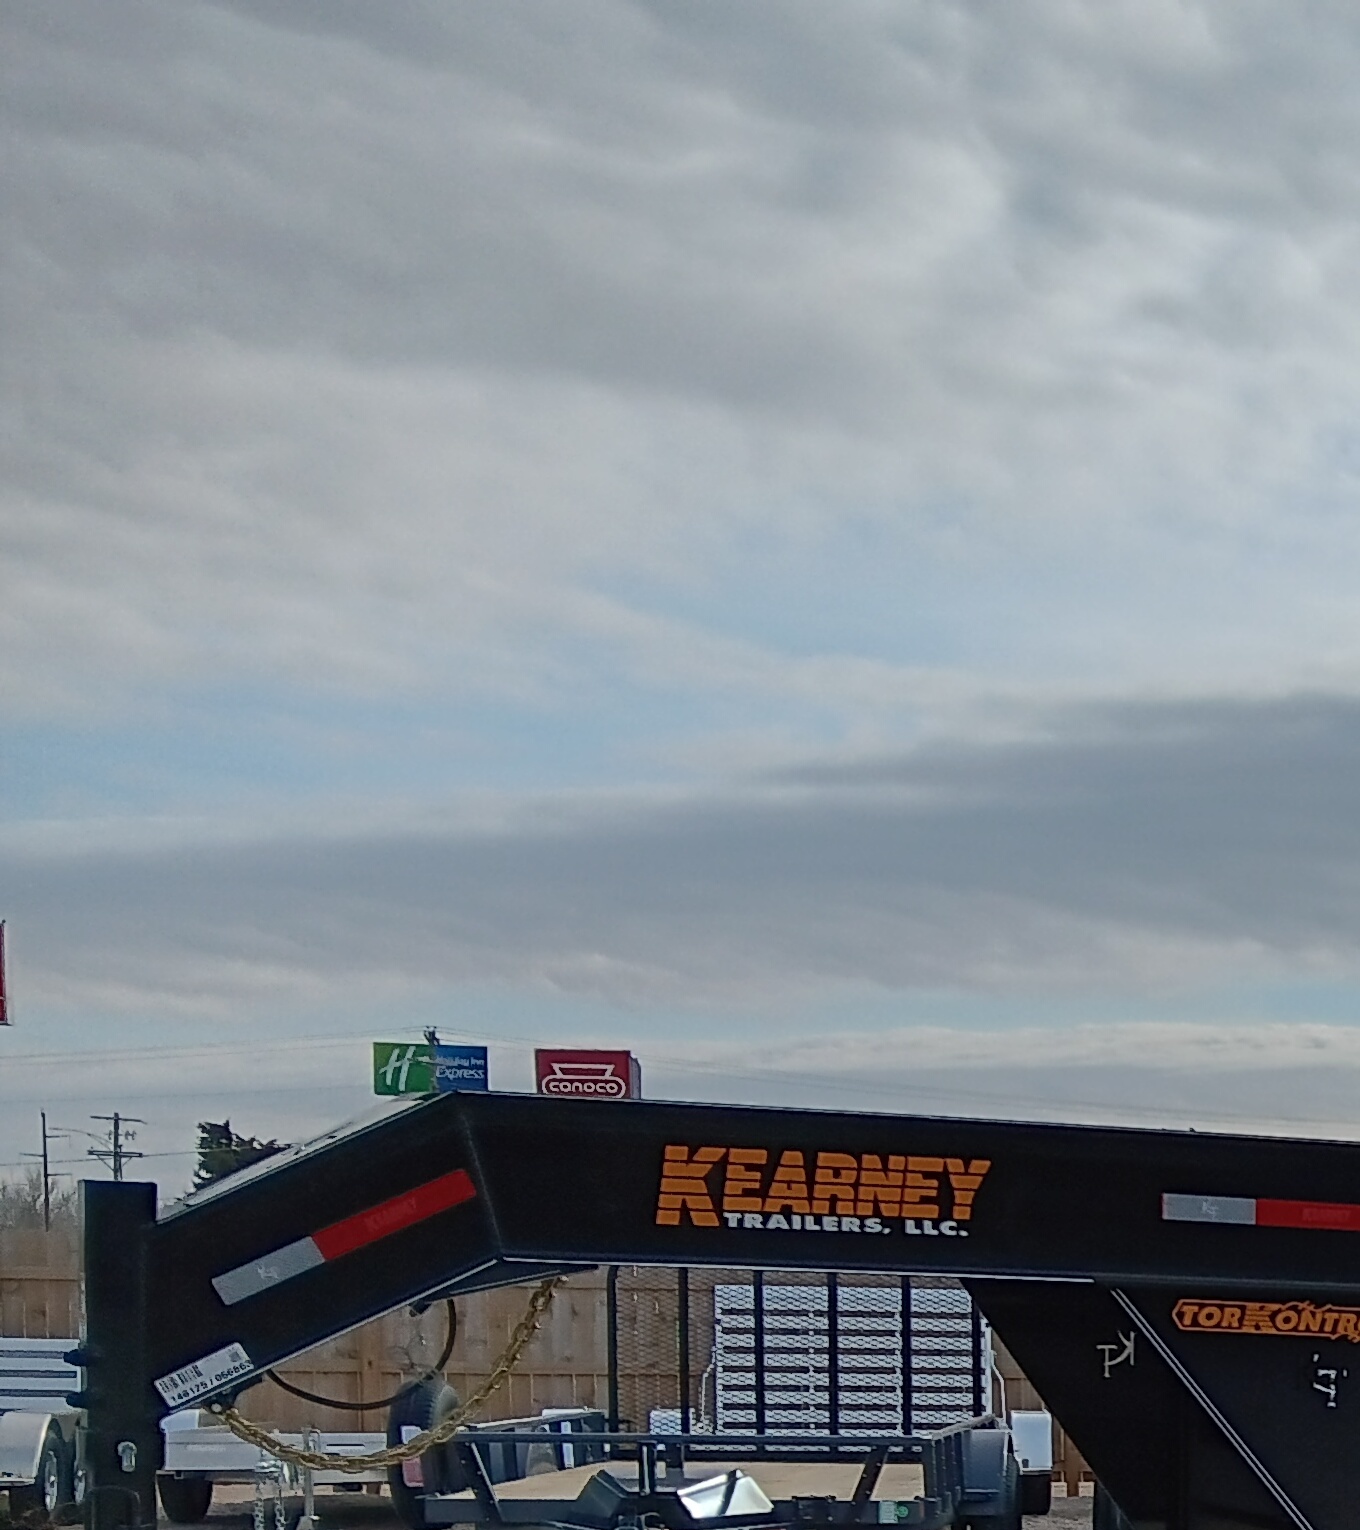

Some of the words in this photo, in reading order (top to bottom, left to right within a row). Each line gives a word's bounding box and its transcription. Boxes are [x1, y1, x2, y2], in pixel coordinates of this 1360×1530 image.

[436, 1066, 485, 1080] Express
[656, 1146, 991, 1227] KEARNEY
[723, 1212, 891, 1234] TRAILERS,
[905, 1220, 969, 1237] LLC.
